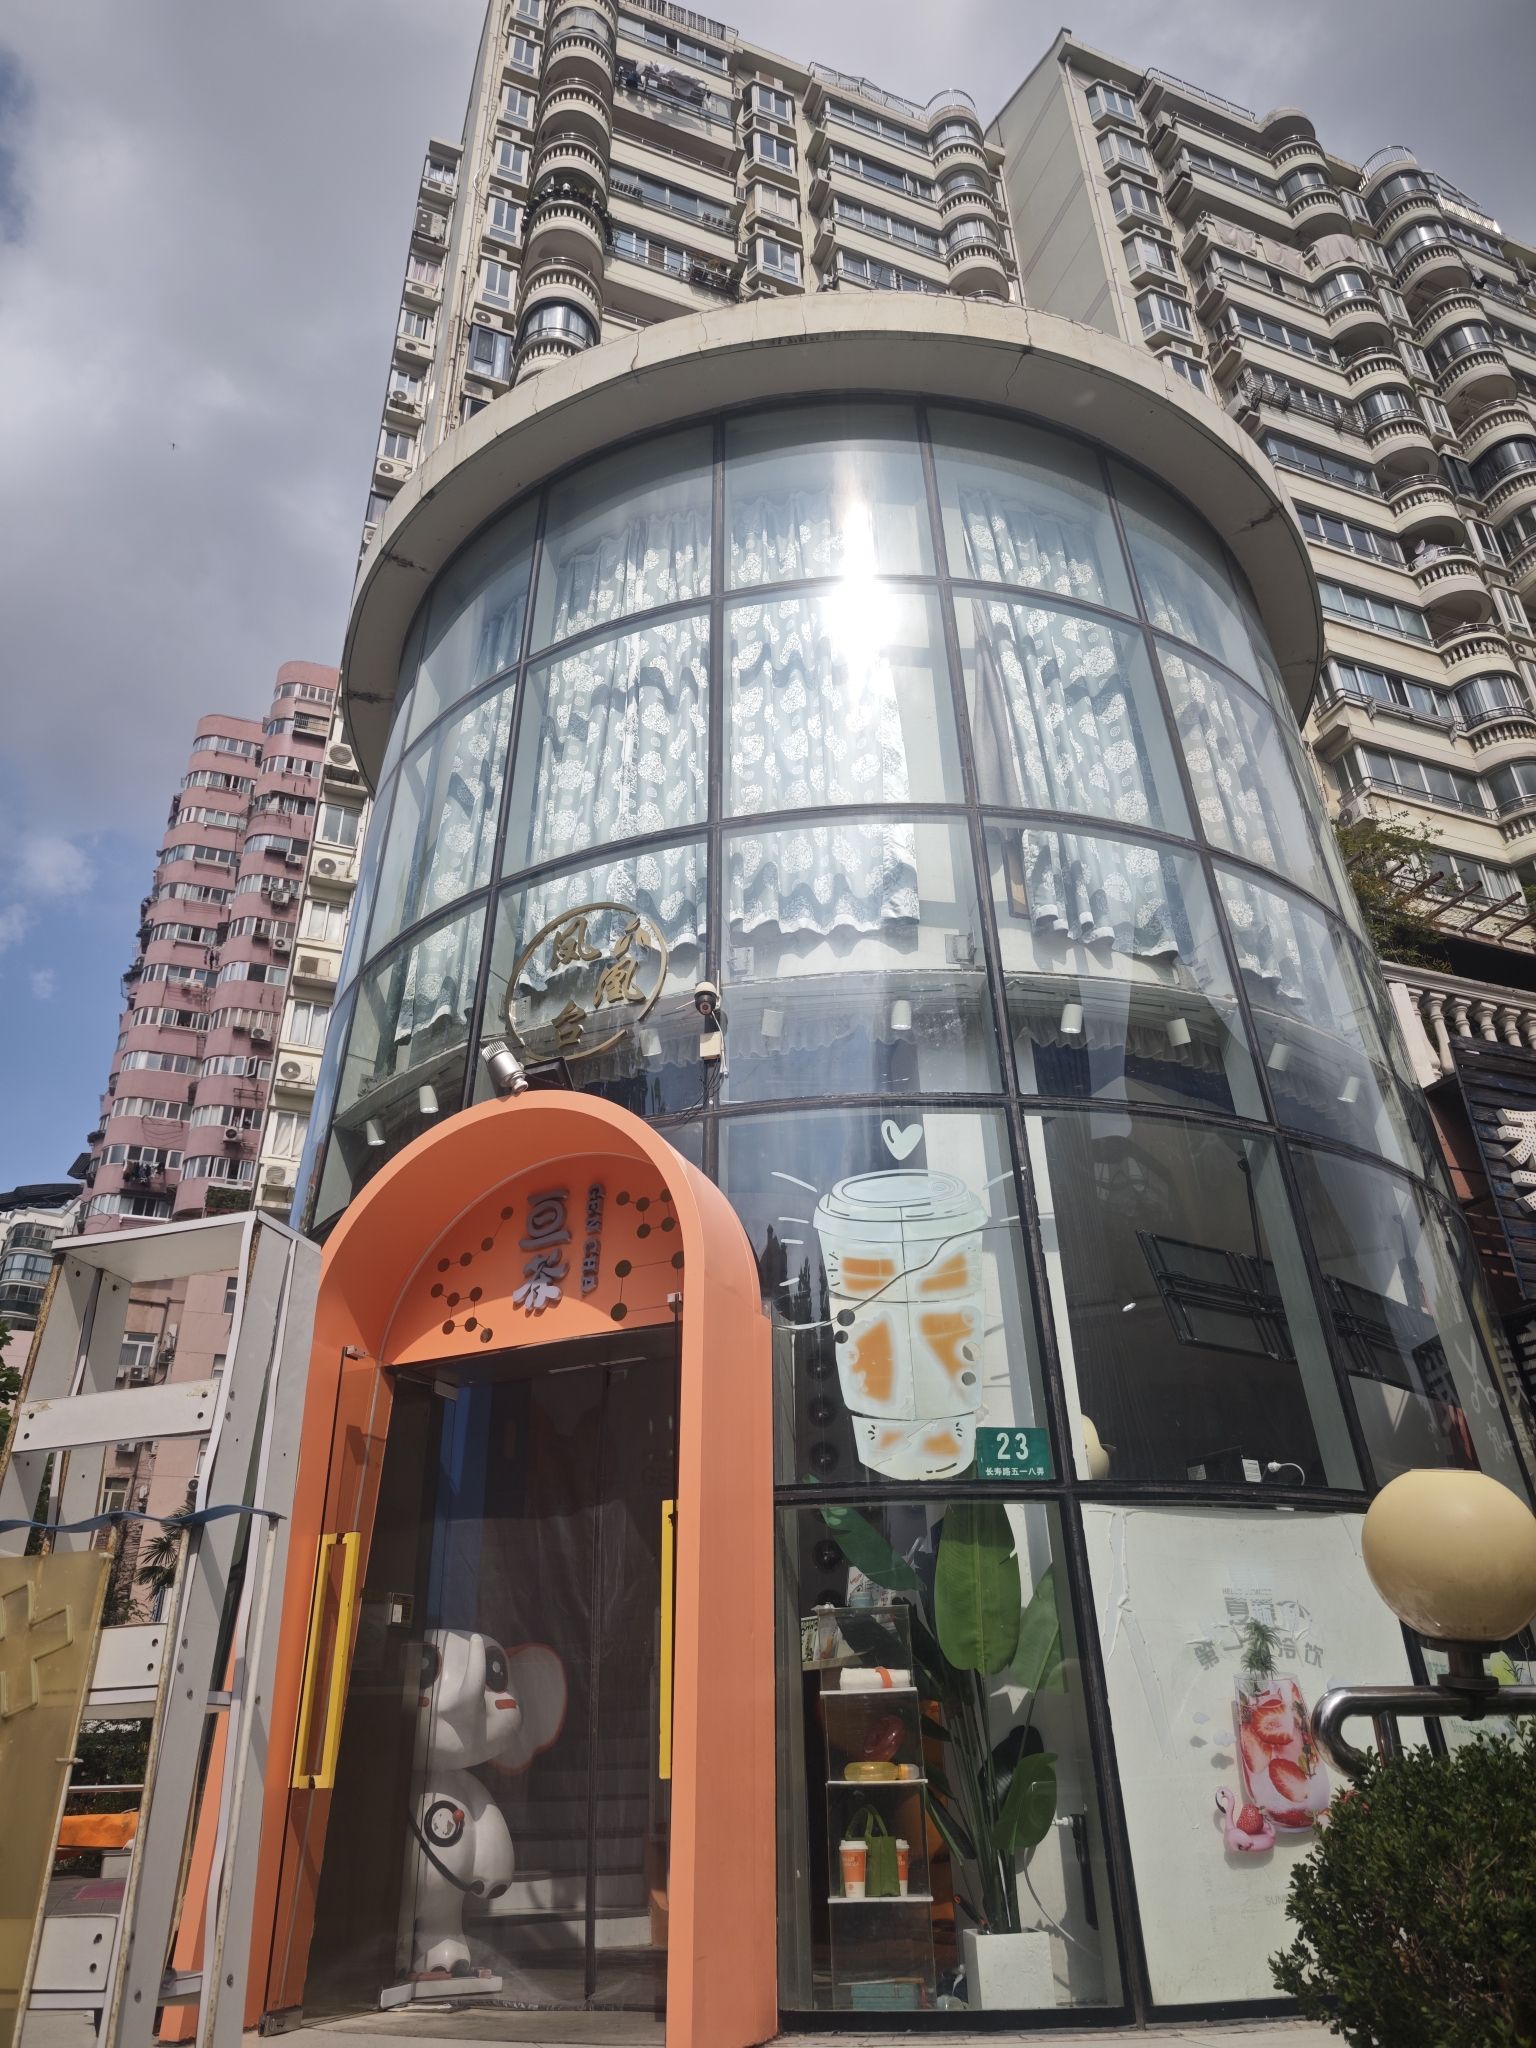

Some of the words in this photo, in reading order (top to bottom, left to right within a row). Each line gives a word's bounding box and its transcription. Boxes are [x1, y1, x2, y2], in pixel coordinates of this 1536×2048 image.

[996, 1432, 1029, 1460] 23
[985, 1467, 1044, 1476] 长寿路五一八弄
